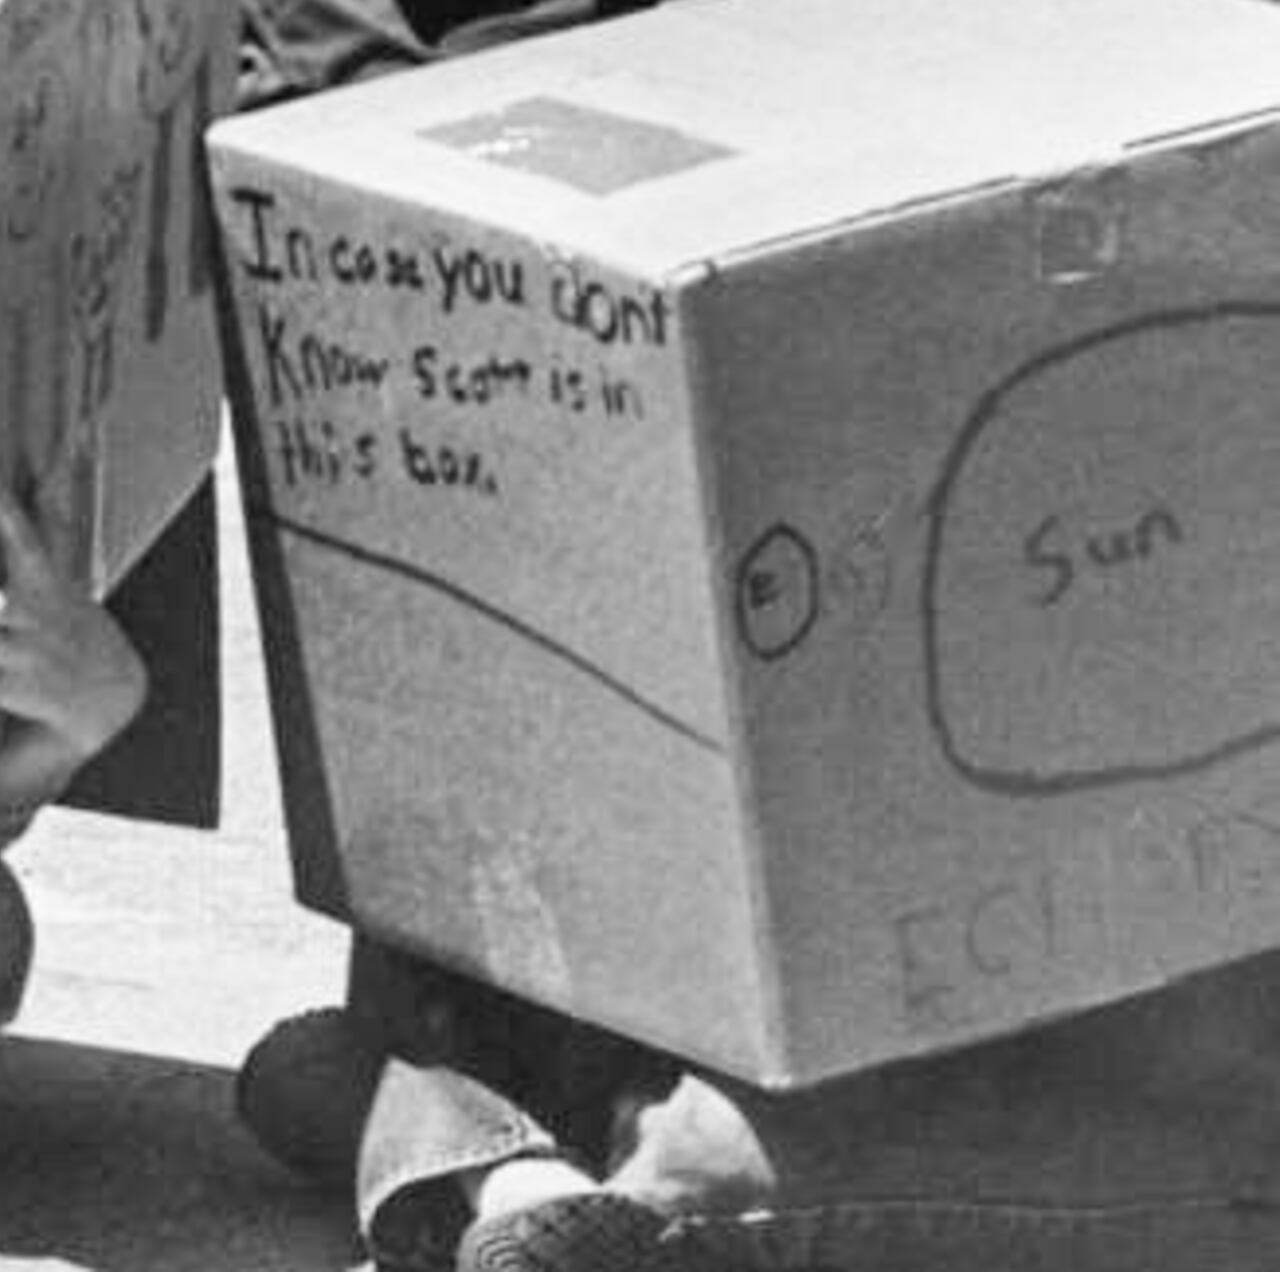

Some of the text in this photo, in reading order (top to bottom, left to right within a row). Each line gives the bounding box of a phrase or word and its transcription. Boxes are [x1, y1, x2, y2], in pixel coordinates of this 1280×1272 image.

[228, 186, 318, 283] In
[434, 246, 525, 314] you
[549, 350, 586, 413] is
[600, 358, 646, 425] in
[275, 418, 378, 488] this
[1022, 507, 1185, 609] Sun
